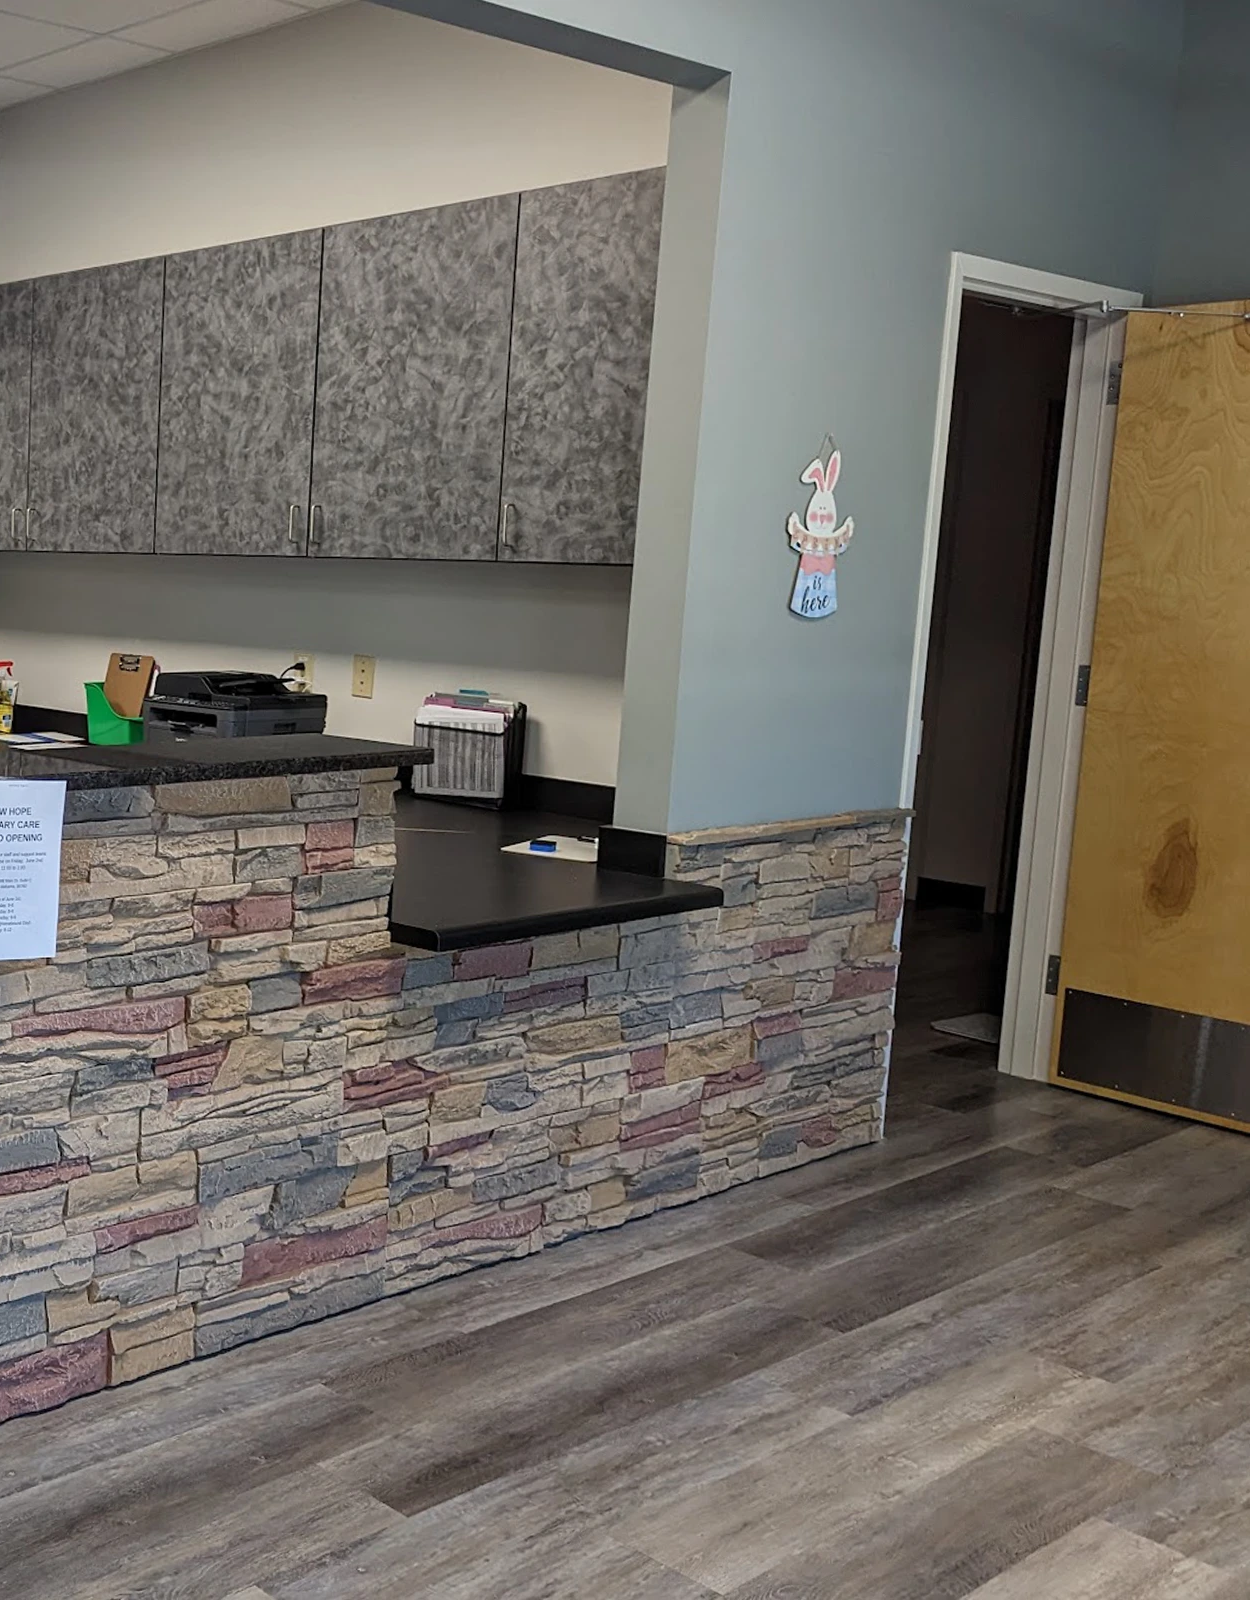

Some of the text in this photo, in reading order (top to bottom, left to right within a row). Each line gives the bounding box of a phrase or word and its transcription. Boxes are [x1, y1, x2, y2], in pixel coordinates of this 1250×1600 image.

[812, 575, 822, 590] is
[801, 586, 830, 614] here
[8, 806, 32, 816] HOPE
[17, 820, 40, 829] CARE
[5, 833, 43, 842] OPENING
